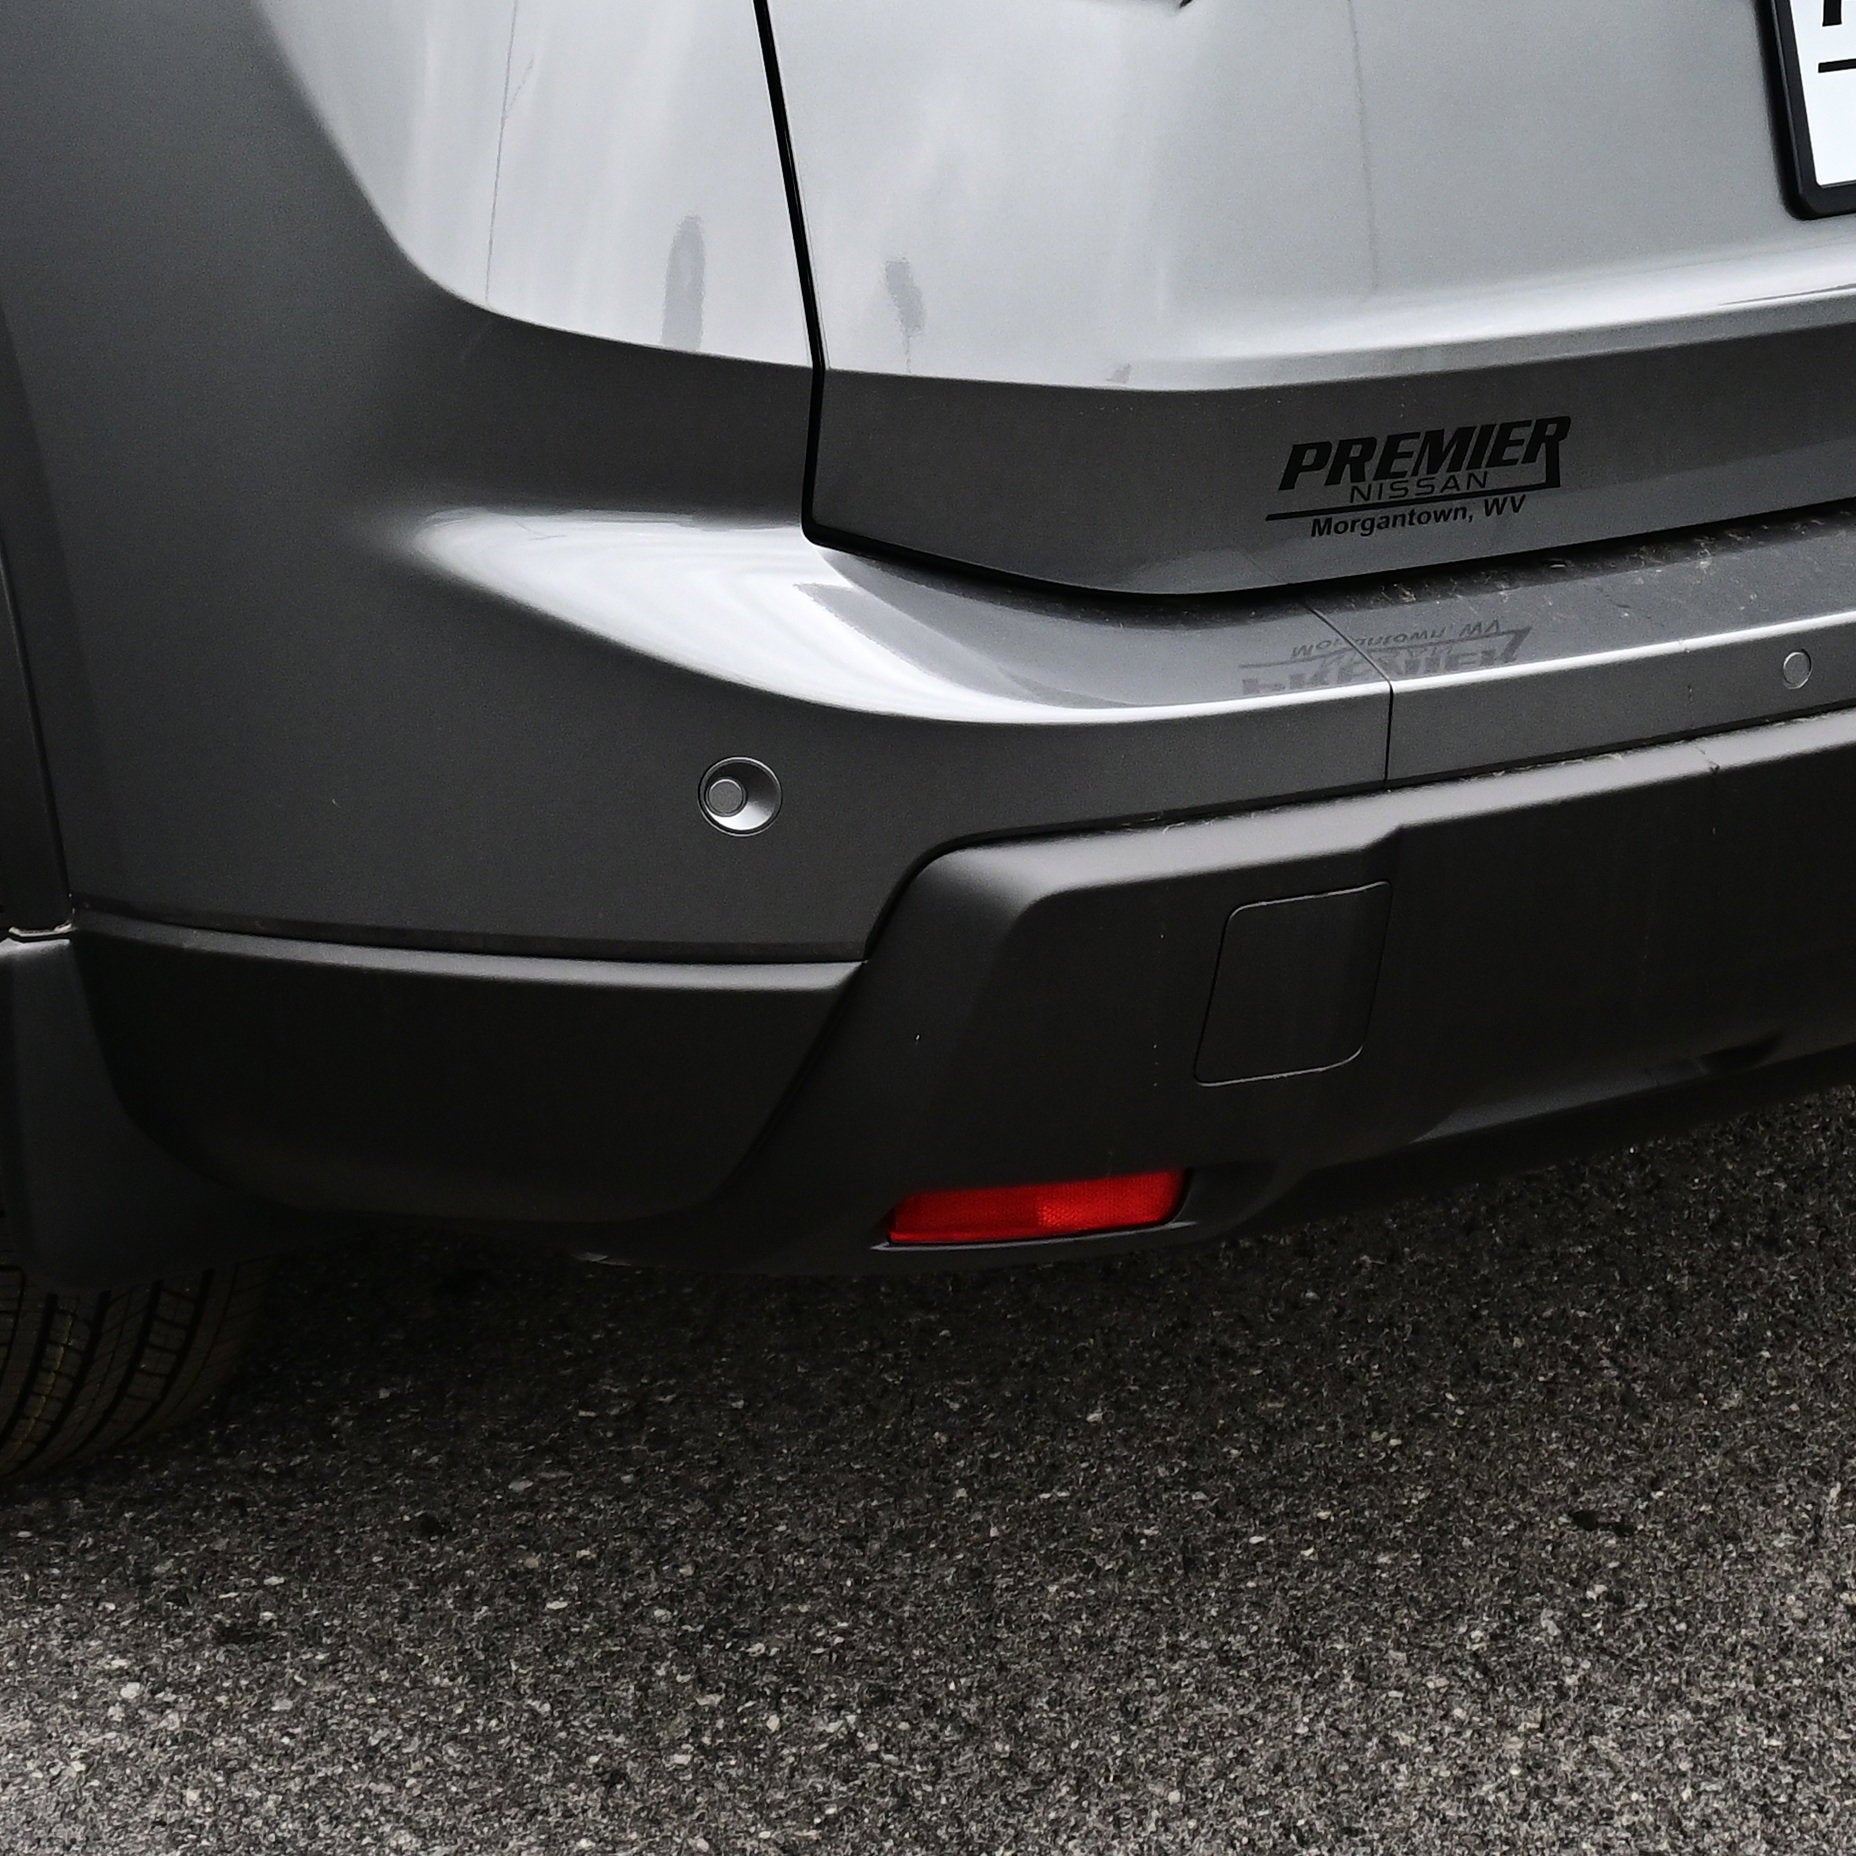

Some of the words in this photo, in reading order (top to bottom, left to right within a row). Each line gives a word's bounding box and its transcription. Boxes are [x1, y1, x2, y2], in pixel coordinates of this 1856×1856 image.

[1278, 415, 1572, 492] PREMIER
[1349, 470, 1489, 504] NISSAN
[1310, 503, 1475, 538] Morgantown,
[1484, 494, 1527, 516] WV
